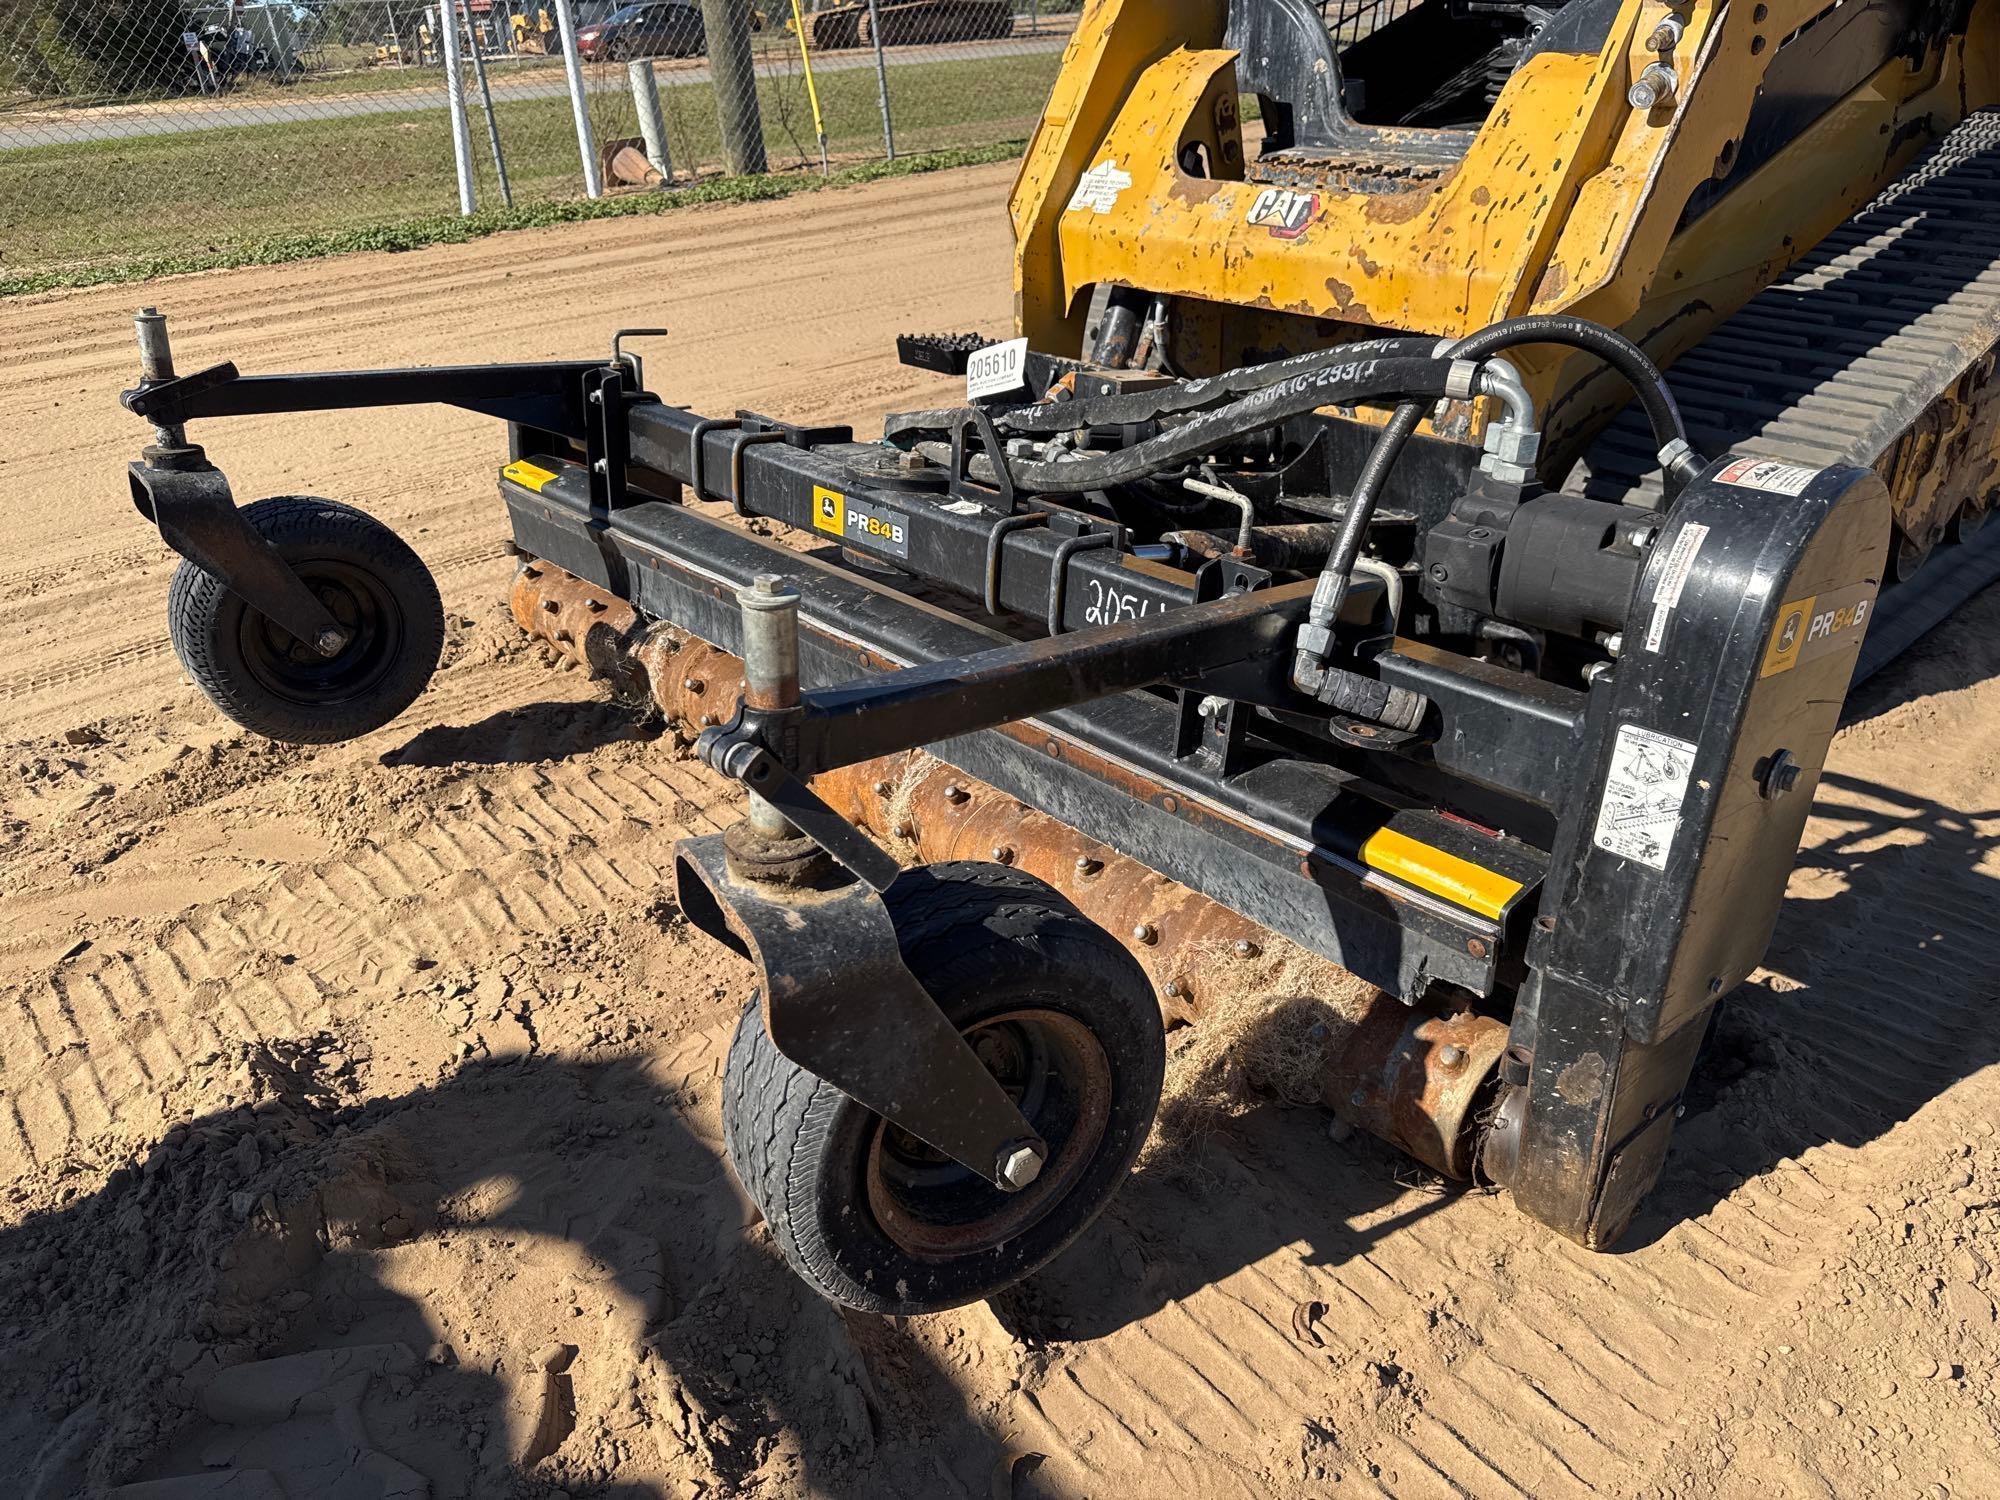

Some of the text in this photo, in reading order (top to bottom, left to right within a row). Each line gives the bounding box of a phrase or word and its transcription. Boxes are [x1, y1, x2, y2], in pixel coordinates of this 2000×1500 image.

[1247, 190, 1312, 228] CAT
[1528, 321, 1550, 330] 18752
[970, 348, 1016, 380] 205610
[847, 509, 904, 543] PR84B
[1807, 600, 1868, 642] PR84B
[1637, 730, 1683, 749] LUBRICATION
